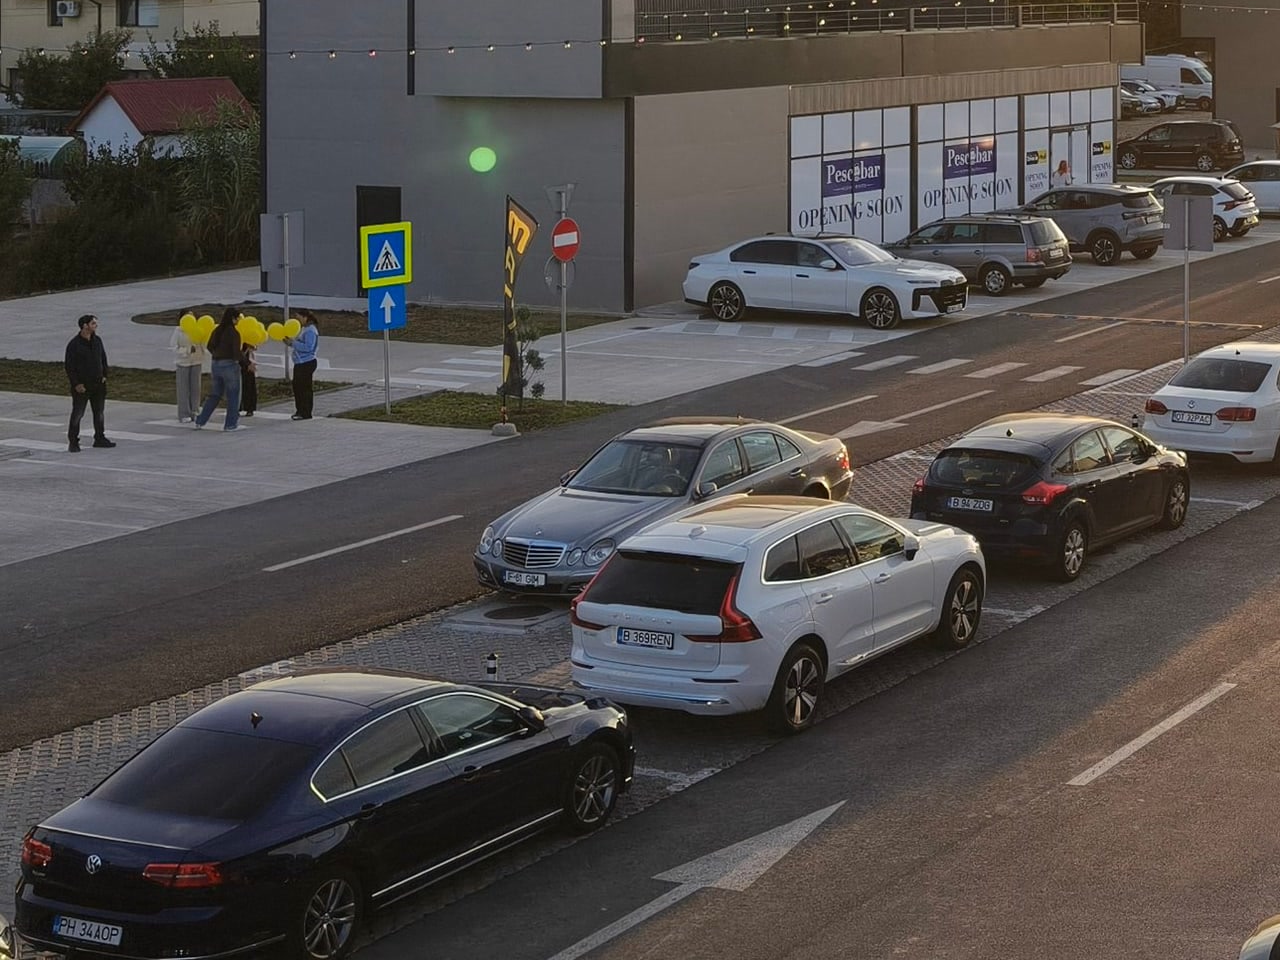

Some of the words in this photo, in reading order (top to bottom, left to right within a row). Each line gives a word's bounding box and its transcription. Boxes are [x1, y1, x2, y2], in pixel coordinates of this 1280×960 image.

[923, 183, 978, 209] OPENING
[980, 177, 1013, 200] SOON
[798, 201, 862, 230] OPENING
[866, 194, 904, 219] SOON
[622, 630, 630, 642] B
[59, 916, 75, 935] PH
